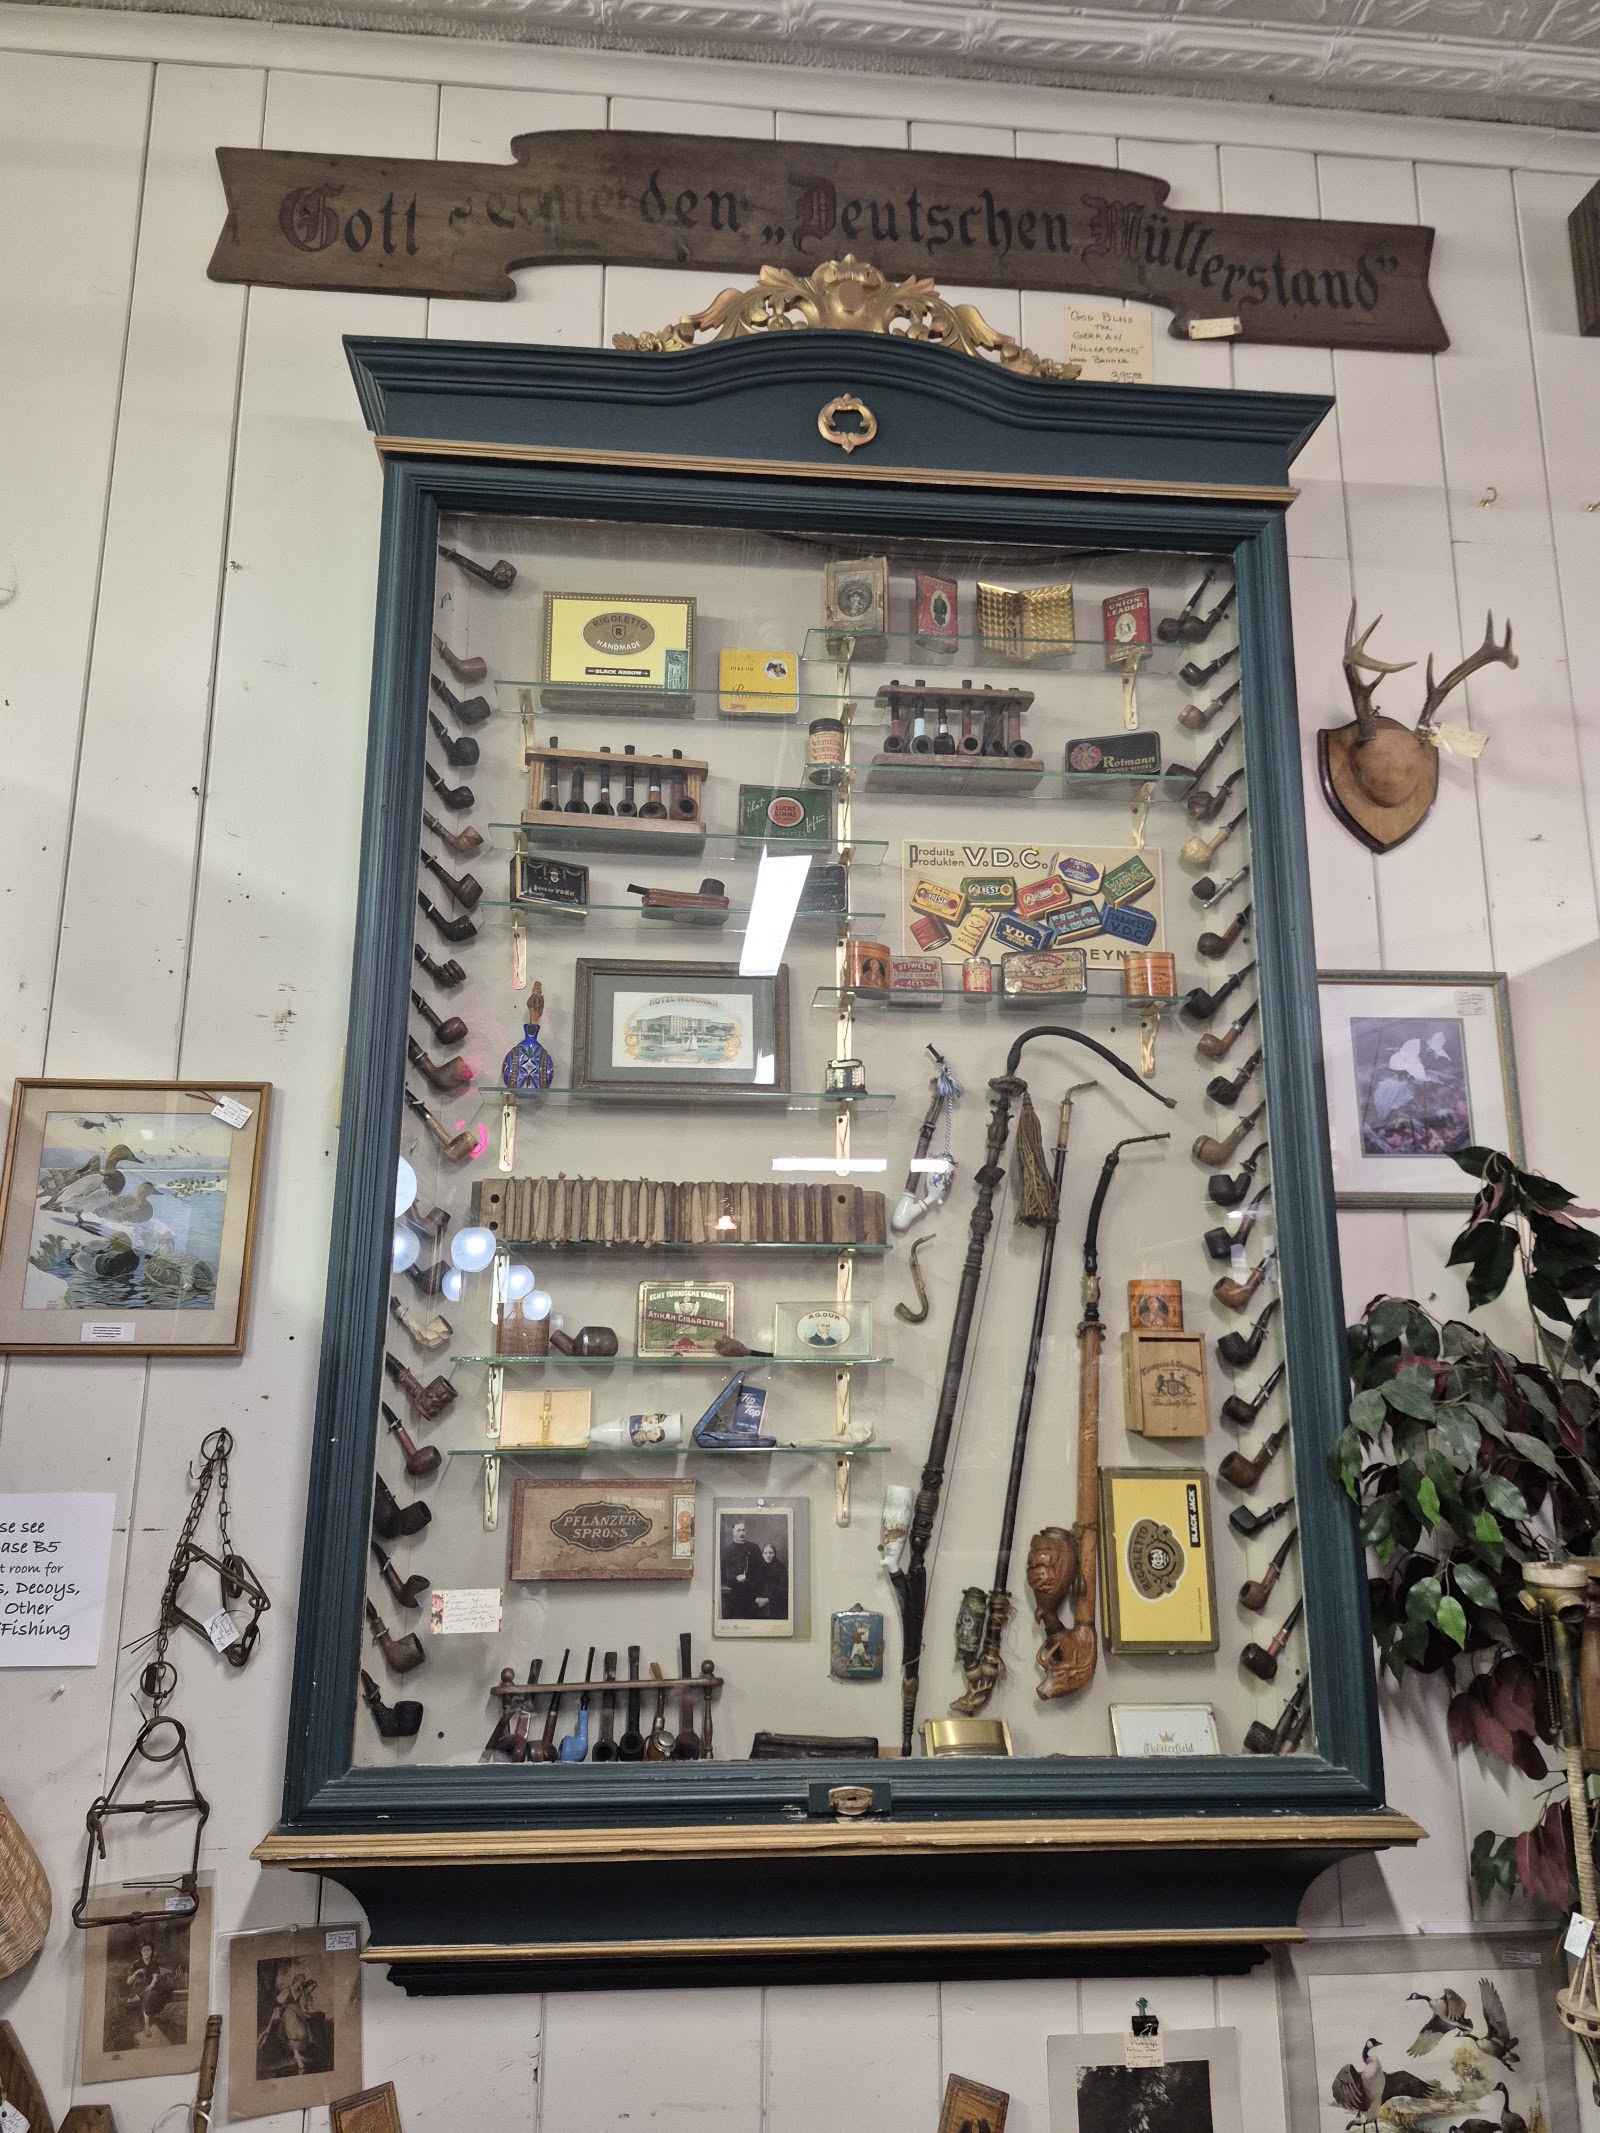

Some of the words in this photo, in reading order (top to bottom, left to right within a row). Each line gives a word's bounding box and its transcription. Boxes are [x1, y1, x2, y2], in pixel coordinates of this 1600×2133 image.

[278, 183, 420, 255] Gott
[640, 168, 744, 232] den
[1106, 602, 1143, 617] LEADER
[1109, 596, 1140, 610] UNION
[592, 615, 648, 630] RIGOLETTO
[615, 628, 623, 636] R
[596, 639, 641, 651] HANDMADE
[1102, 755, 1156, 768] Rotmann
[962, 846, 1048, 869] V.D.C.
[555, 888, 575, 897] YORK
[981, 885, 1000, 894] BEST
[898, 962, 932, 971] BETWEEN
[649, 995, 676, 1006] HOTEL
[649, 1291, 665, 1301] ECHT
[666, 1289, 700, 1298] TÜRKISCHE
[648, 1310, 676, 1320] ATIKAH
[677, 1314, 724, 1328] CIGARETTEN
[740, 1392, 757, 1404] Tip
[744, 1404, 761, 1418] Top
[1187, 1488, 1197, 1512] JACK
[20, 1521, 45, 1533] see
[572, 1527, 630, 1539] SPROSS
[1190, 1513, 1200, 1544] BLACK
[0, 1542, 28, 1554] ase
[32, 1540, 62, 1554] B5
[9, 1564, 41, 1574] room
[44, 1561, 64, 1577] for
[16, 1581, 81, 1602] Decoys,
[4, 1600, 54, 1615] Other
[1143, 1742, 1195, 1754] Chesterfield
